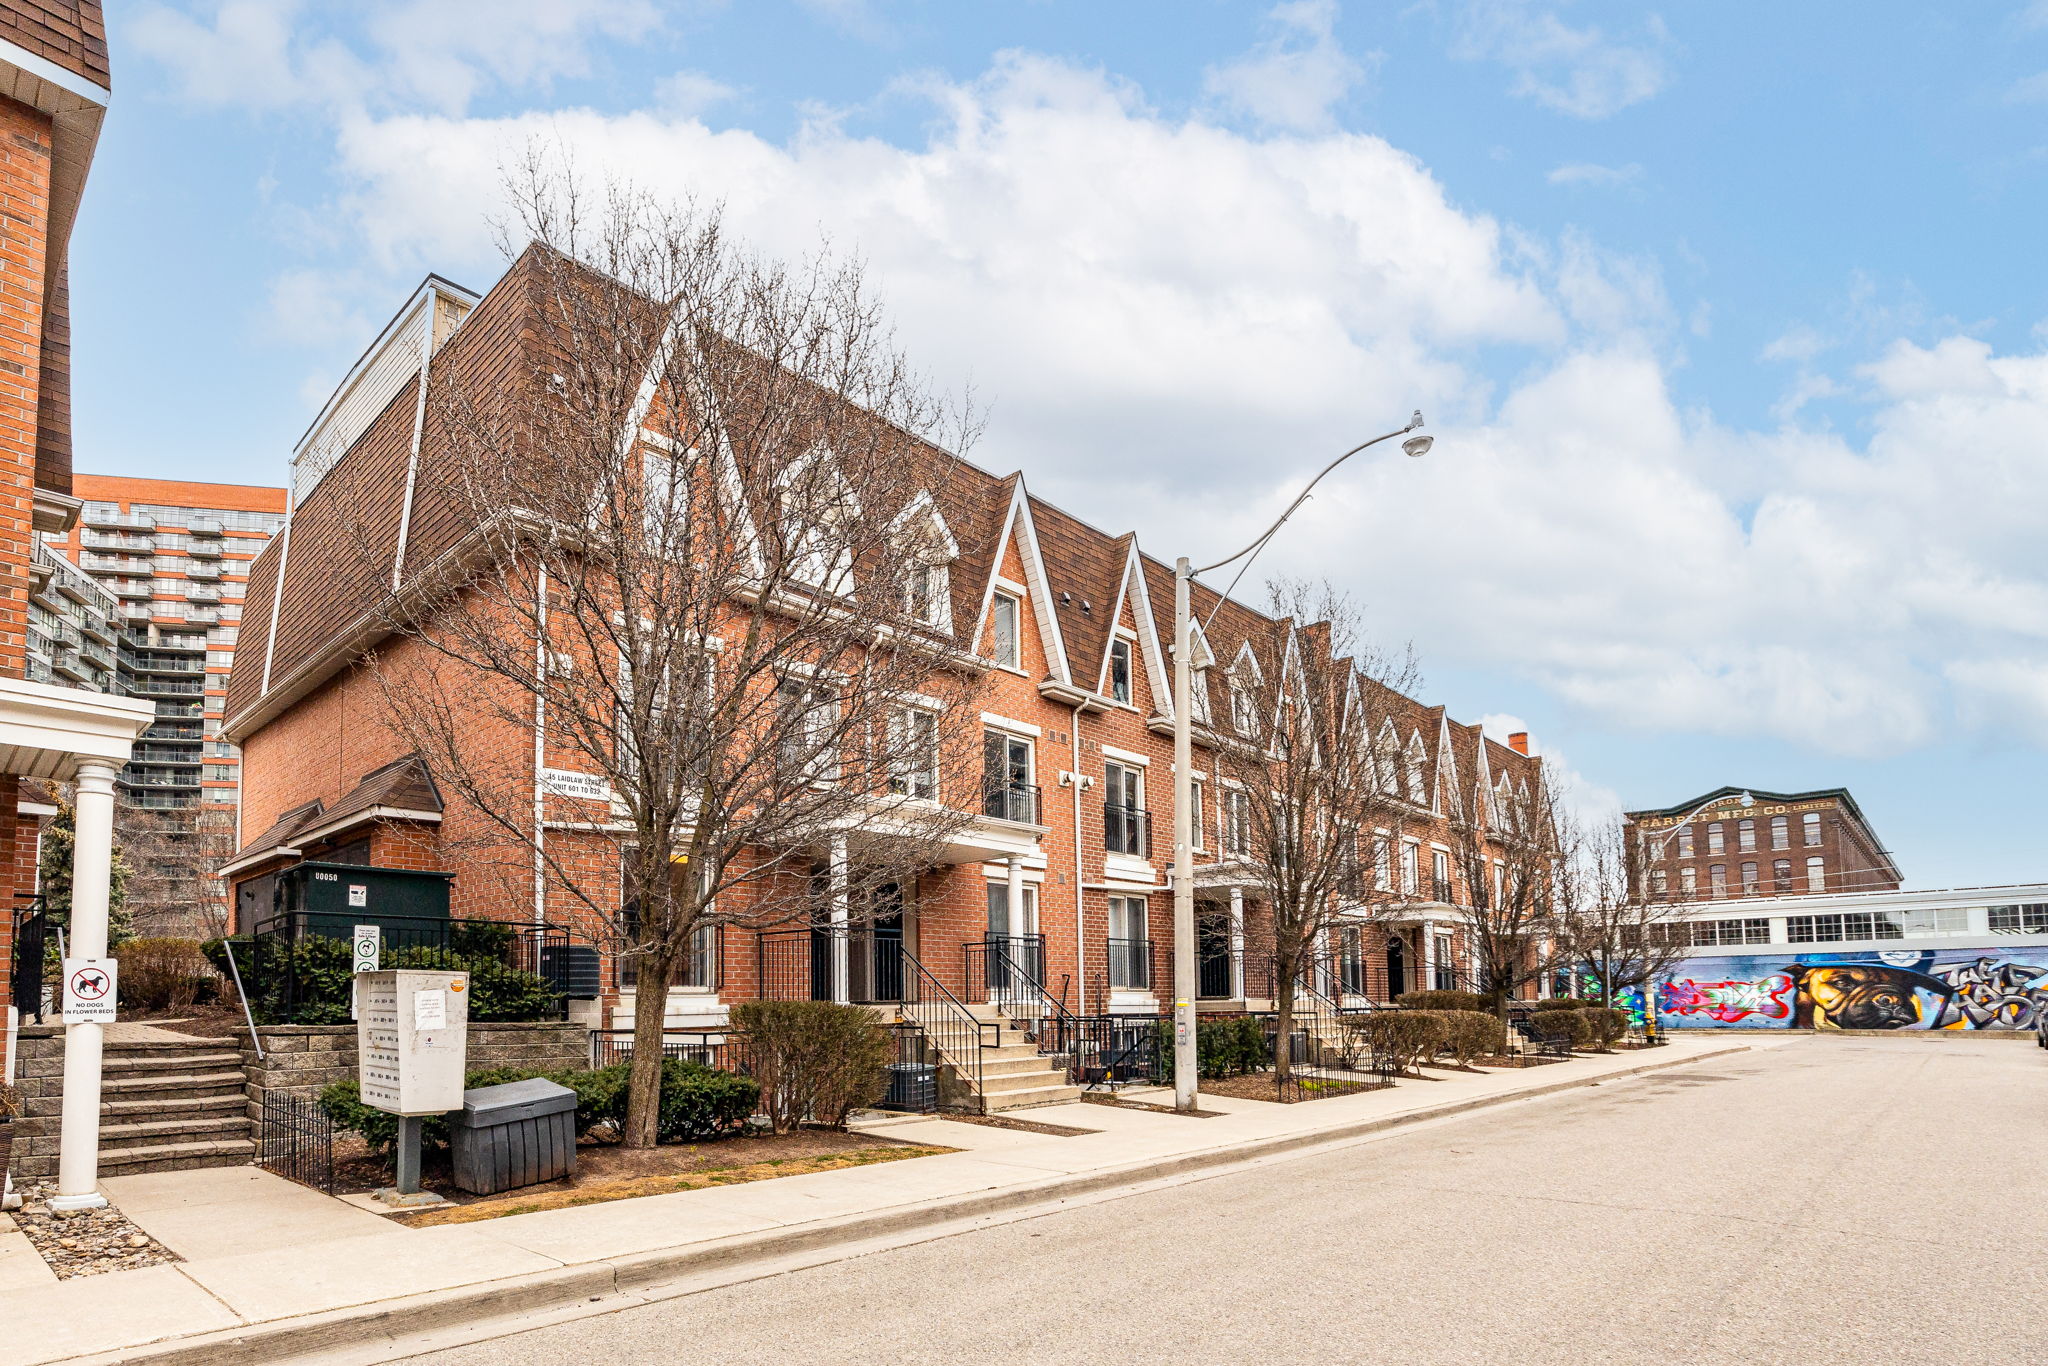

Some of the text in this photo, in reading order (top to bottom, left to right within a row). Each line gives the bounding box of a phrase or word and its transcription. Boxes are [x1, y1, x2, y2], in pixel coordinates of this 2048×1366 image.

[557, 775, 583, 784] LAIDLAW
[553, 783, 567, 791] UNIT
[581, 786, 589, 794] TO
[1705, 798, 1758, 811] TORONO
[1640, 802, 1833, 828] CARPET MFG. CO. LIMITED
